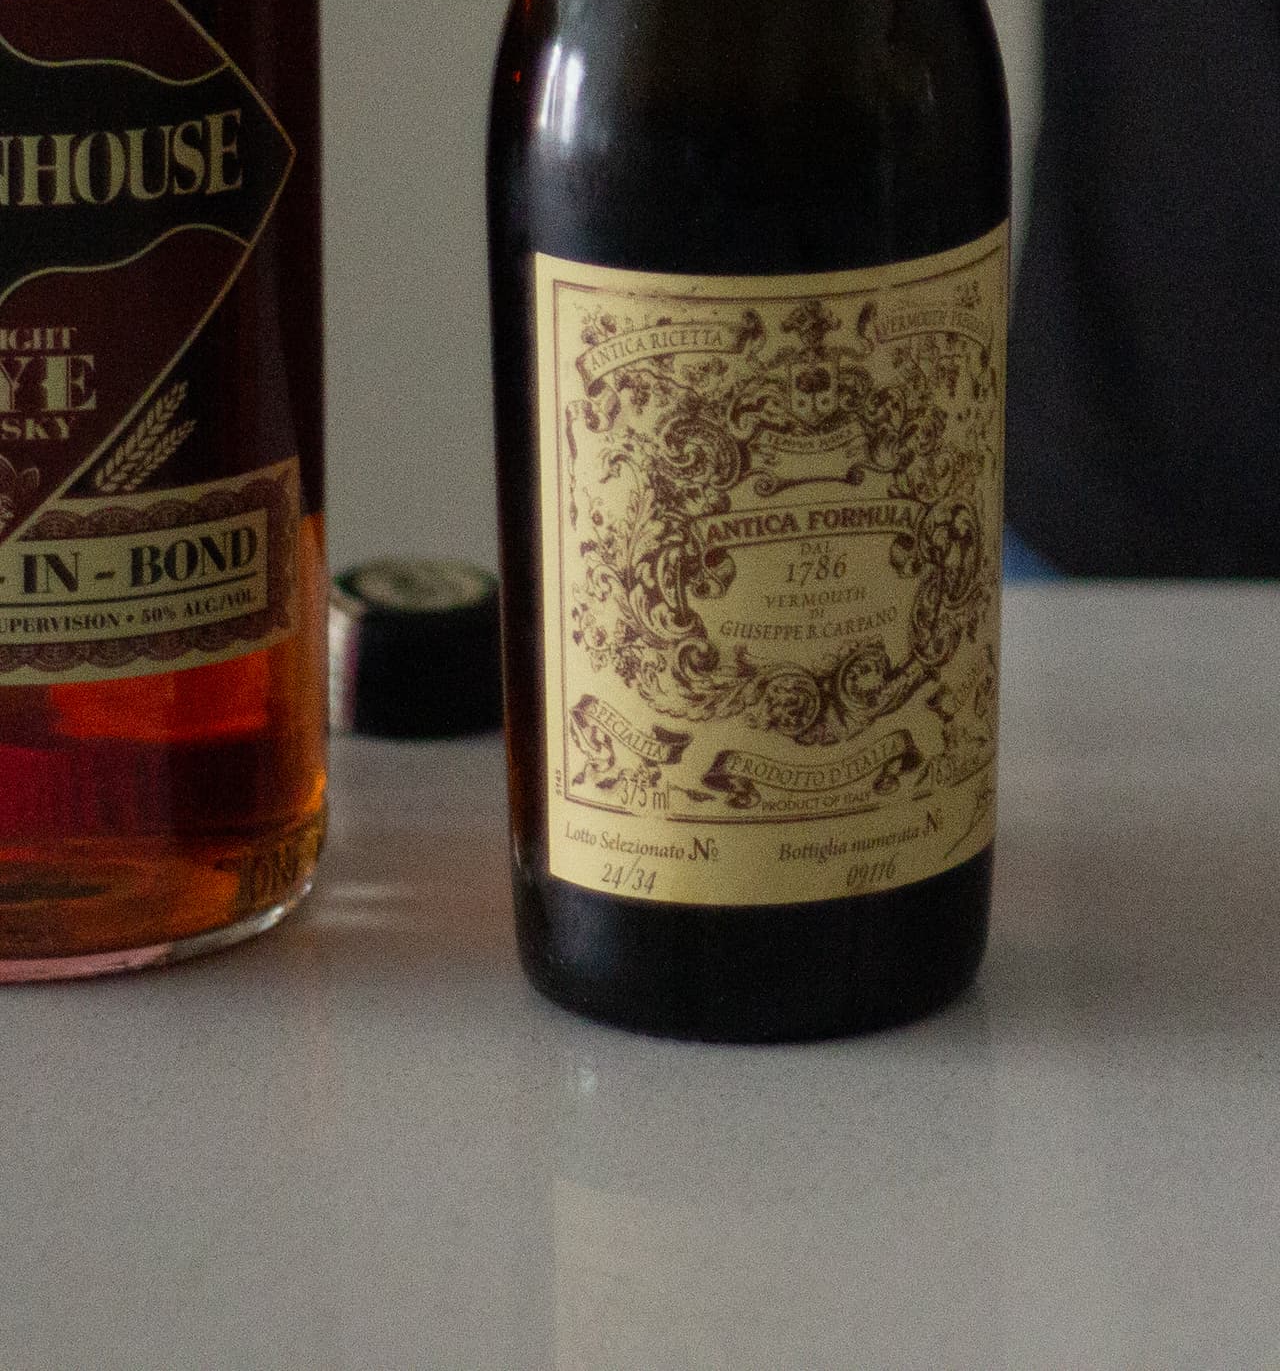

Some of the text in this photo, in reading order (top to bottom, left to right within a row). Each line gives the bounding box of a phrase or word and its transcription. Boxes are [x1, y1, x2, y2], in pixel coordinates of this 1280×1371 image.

[591, 330, 723, 371] ANTICA RICETTA
[708, 506, 915, 545] ANTICA FORMULA
[800, 541, 832, 556] DAL
[785, 552, 848, 587] 1786
[764, 586, 866, 607] VERMOUTH
[810, 608, 824, 619] DI
[720, 606, 898, 640] GIUSEPPE CARPANO
[729, 754, 825, 787] PRODOTTO
[620, 775, 670, 810] 375 ml
[762, 791, 872, 812] PRODUCT OF ITALY
[565, 821, 685, 860] Lotto Selezionato
[778, 837, 847, 864] Bottiglia
[601, 856, 658, 894] 24/34
